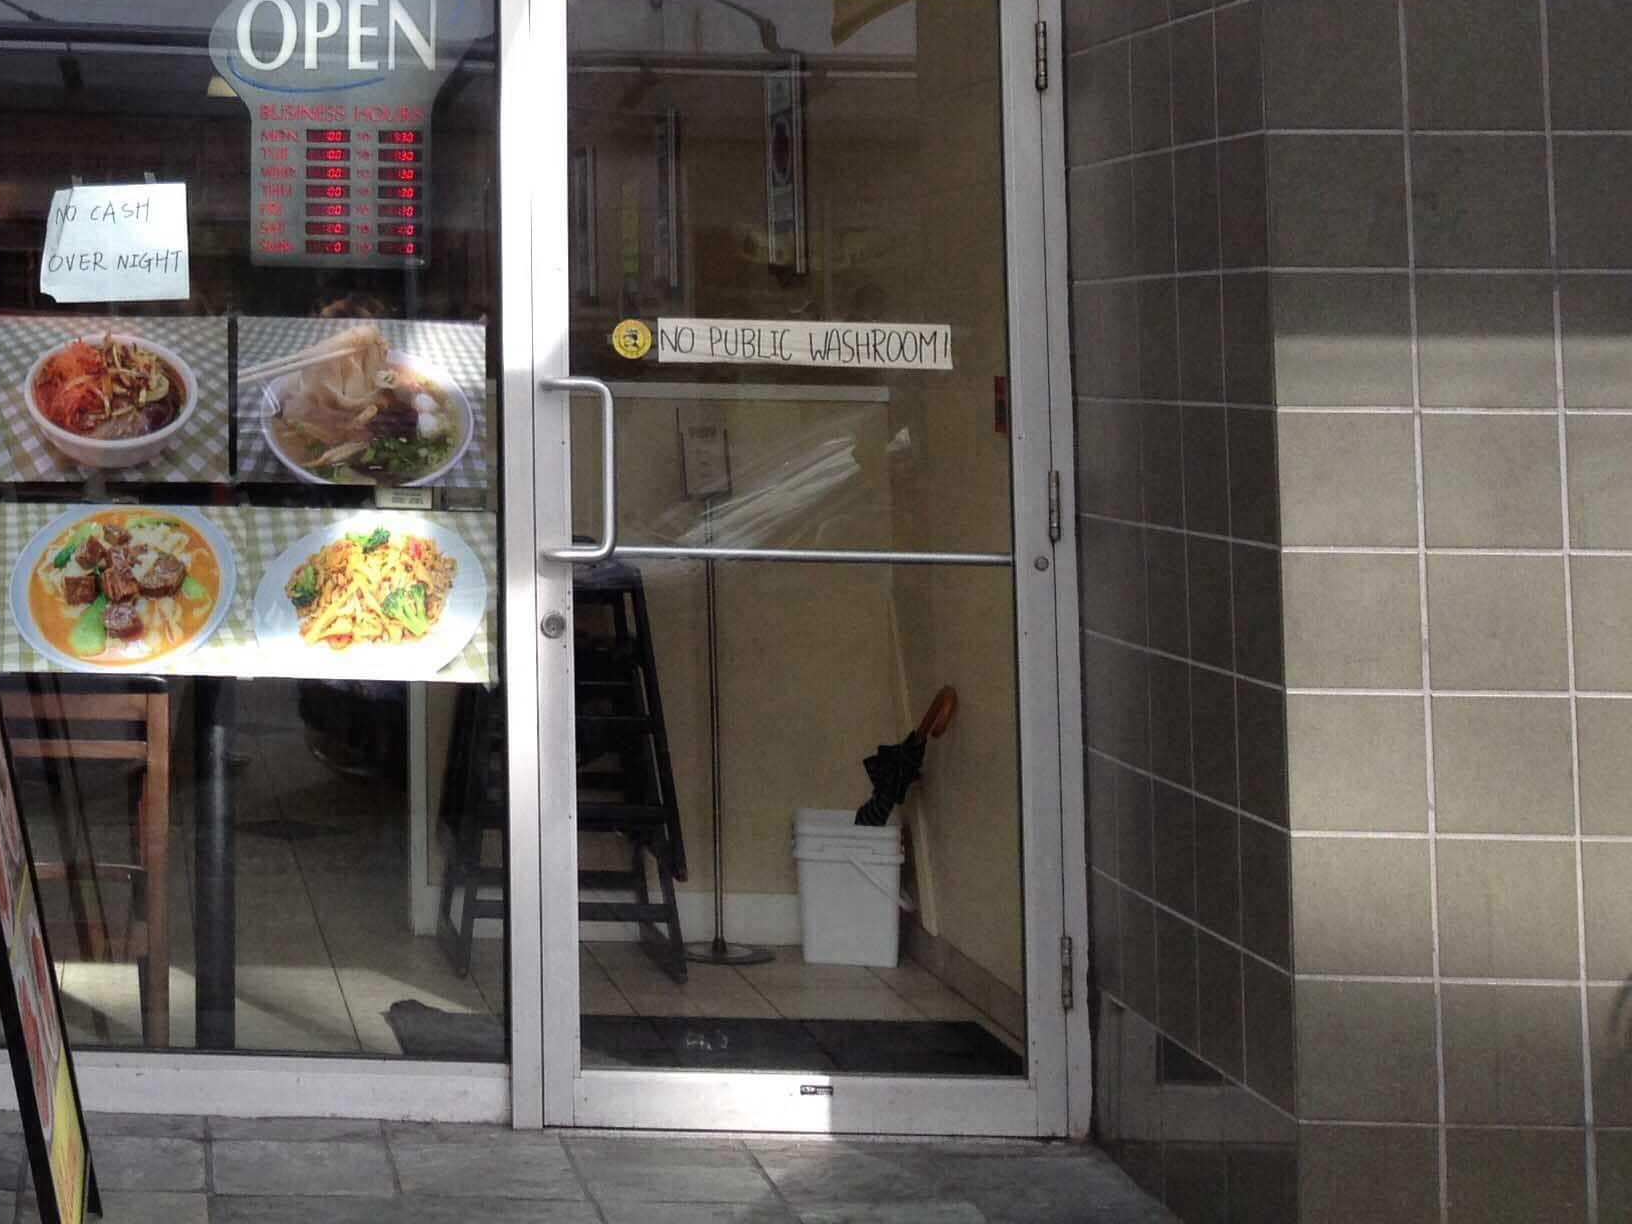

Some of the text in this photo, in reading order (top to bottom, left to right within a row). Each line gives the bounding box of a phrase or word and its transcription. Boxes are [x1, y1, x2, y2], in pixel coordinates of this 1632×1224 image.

[259, 103, 345, 121] BUSINESS
[55, 197, 151, 224] NO CASH
[48, 249, 184, 274] OVER NIGHT
[660, 327, 695, 354] NO
[709, 327, 793, 362] PUBLIC
[809, 328, 950, 365] WASHROOM!
